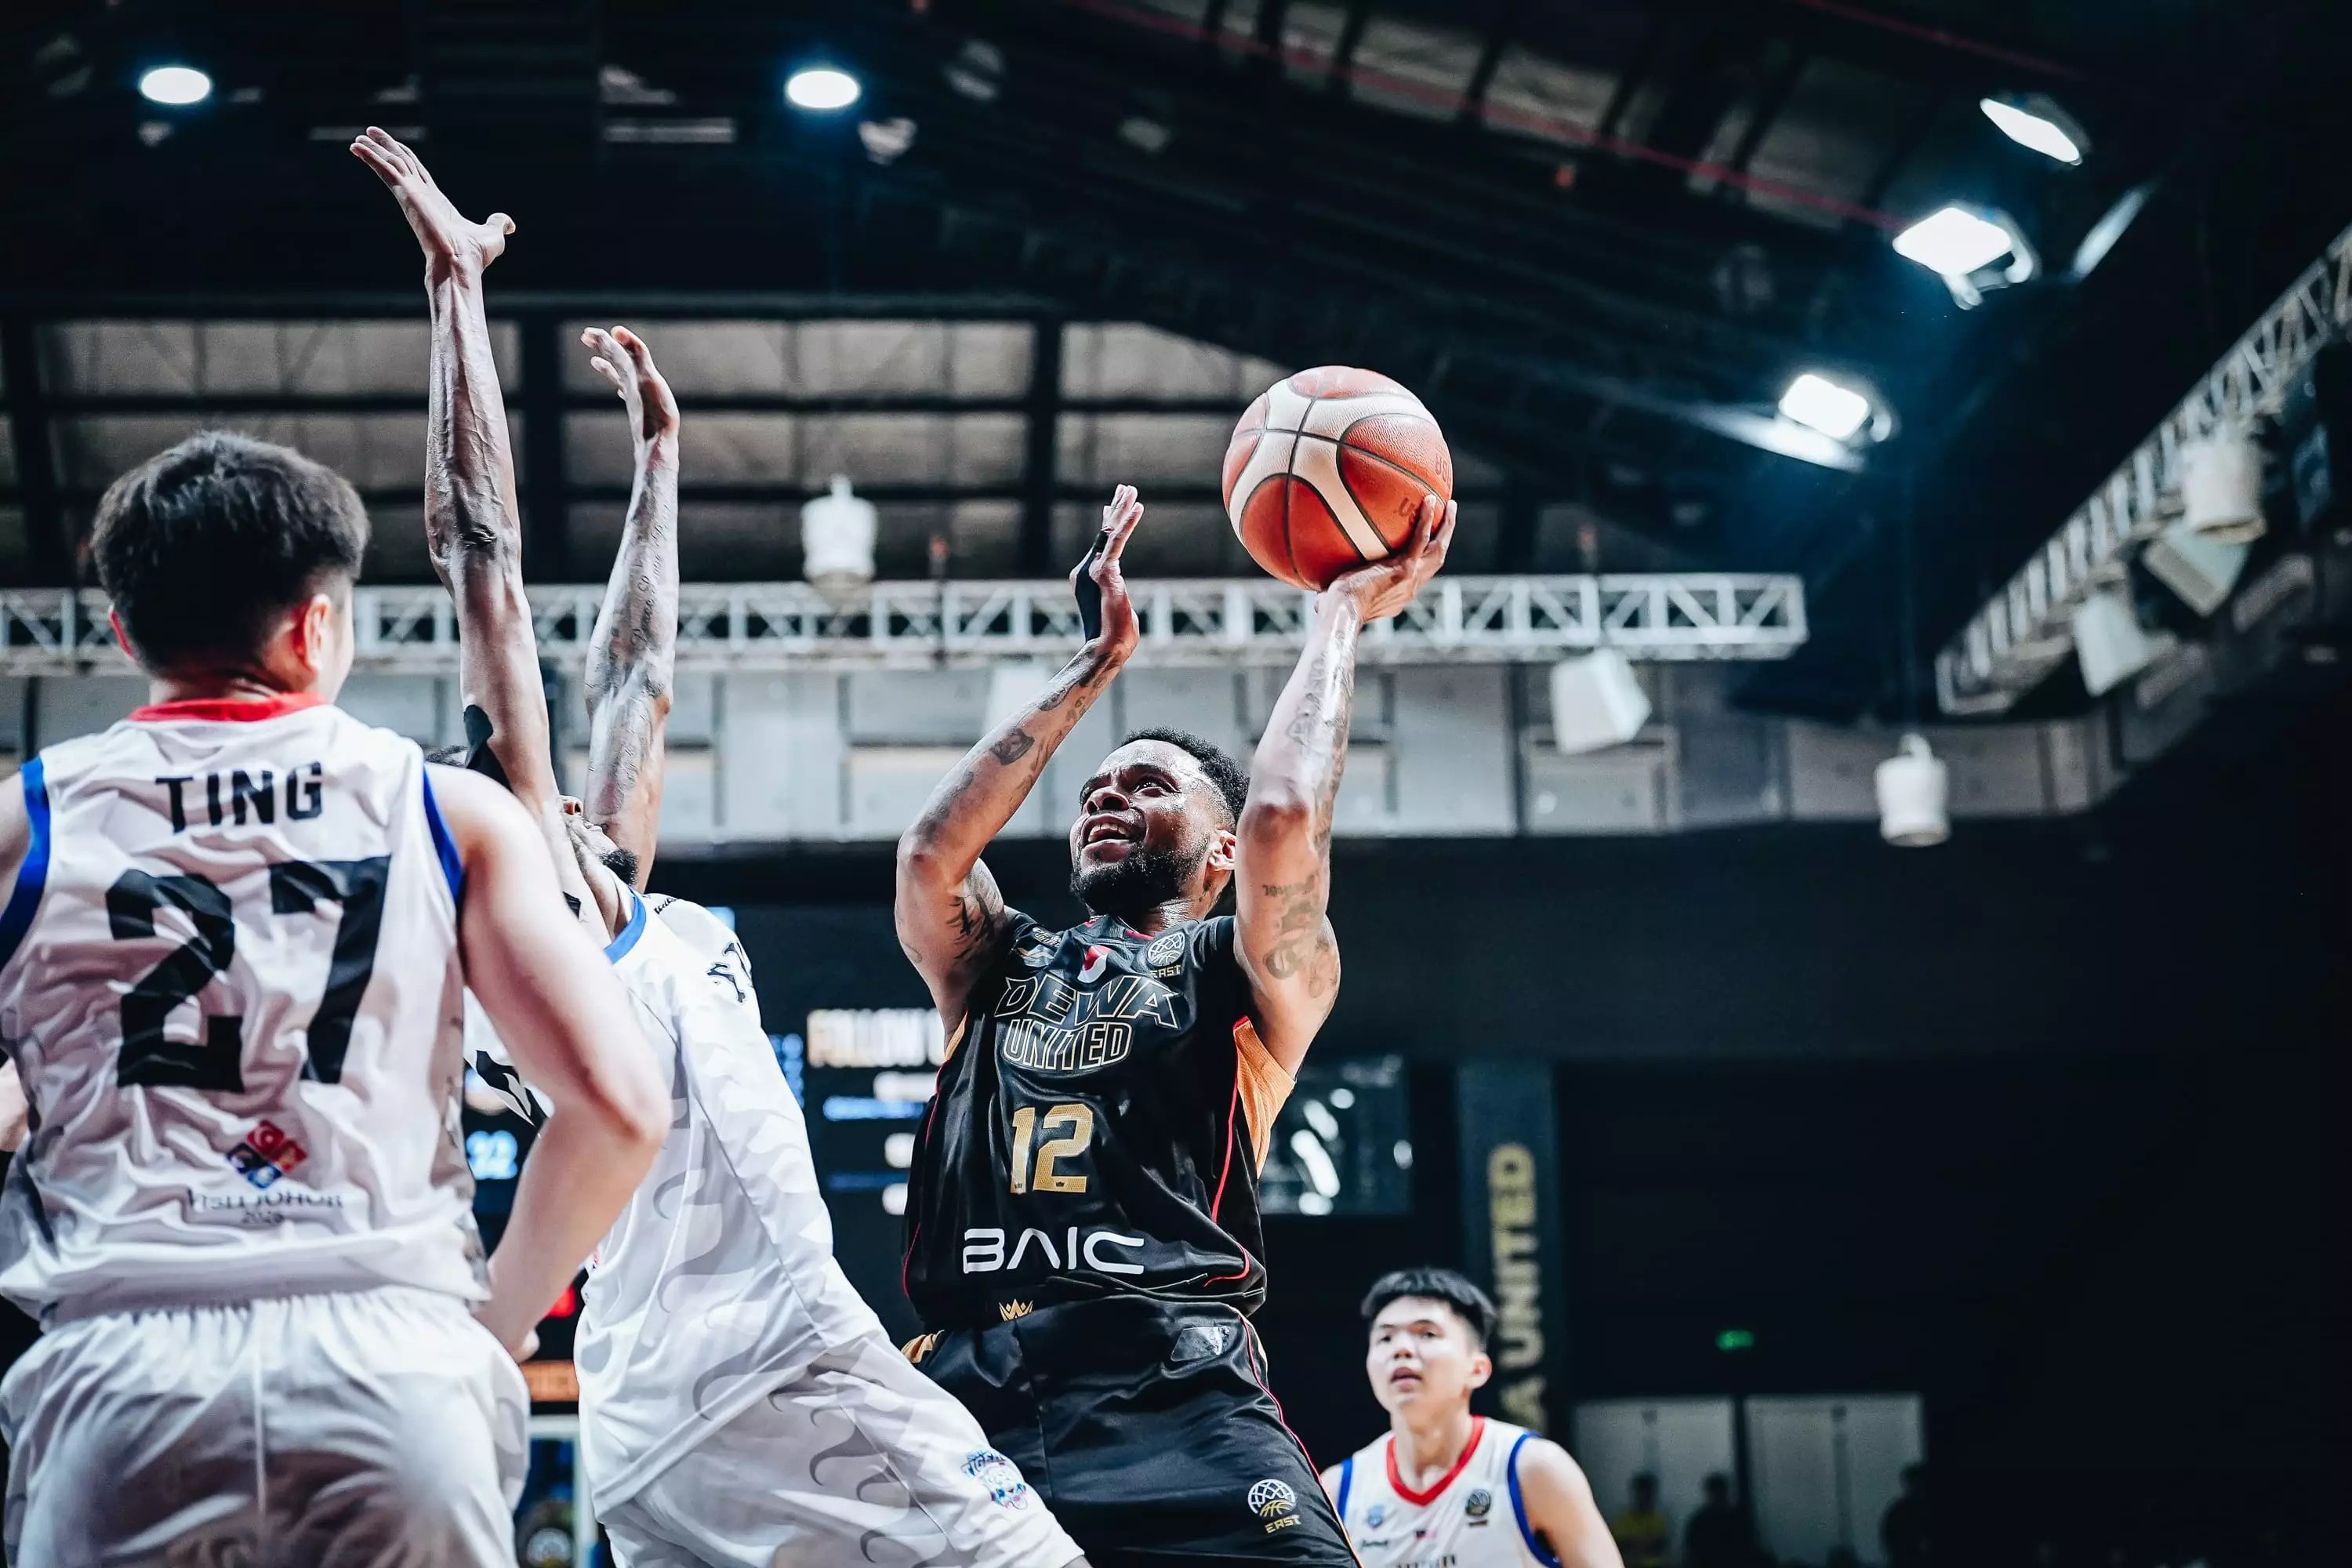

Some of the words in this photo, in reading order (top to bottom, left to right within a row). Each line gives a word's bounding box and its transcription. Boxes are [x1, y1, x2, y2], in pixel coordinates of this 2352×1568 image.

[155, 761, 322, 833] TING
[106, 854, 393, 1093] 27
[1150, 964, 1181, 978] EAST
[995, 974, 1181, 1029] DEWA
[1004, 1019, 1133, 1070] UNITED
[1011, 1104, 1094, 1194] 12
[963, 1226, 1145, 1274] BAIC
[1486, 1144, 1544, 1370] UNITED
[1265, 1514, 1301, 1534] EAST
